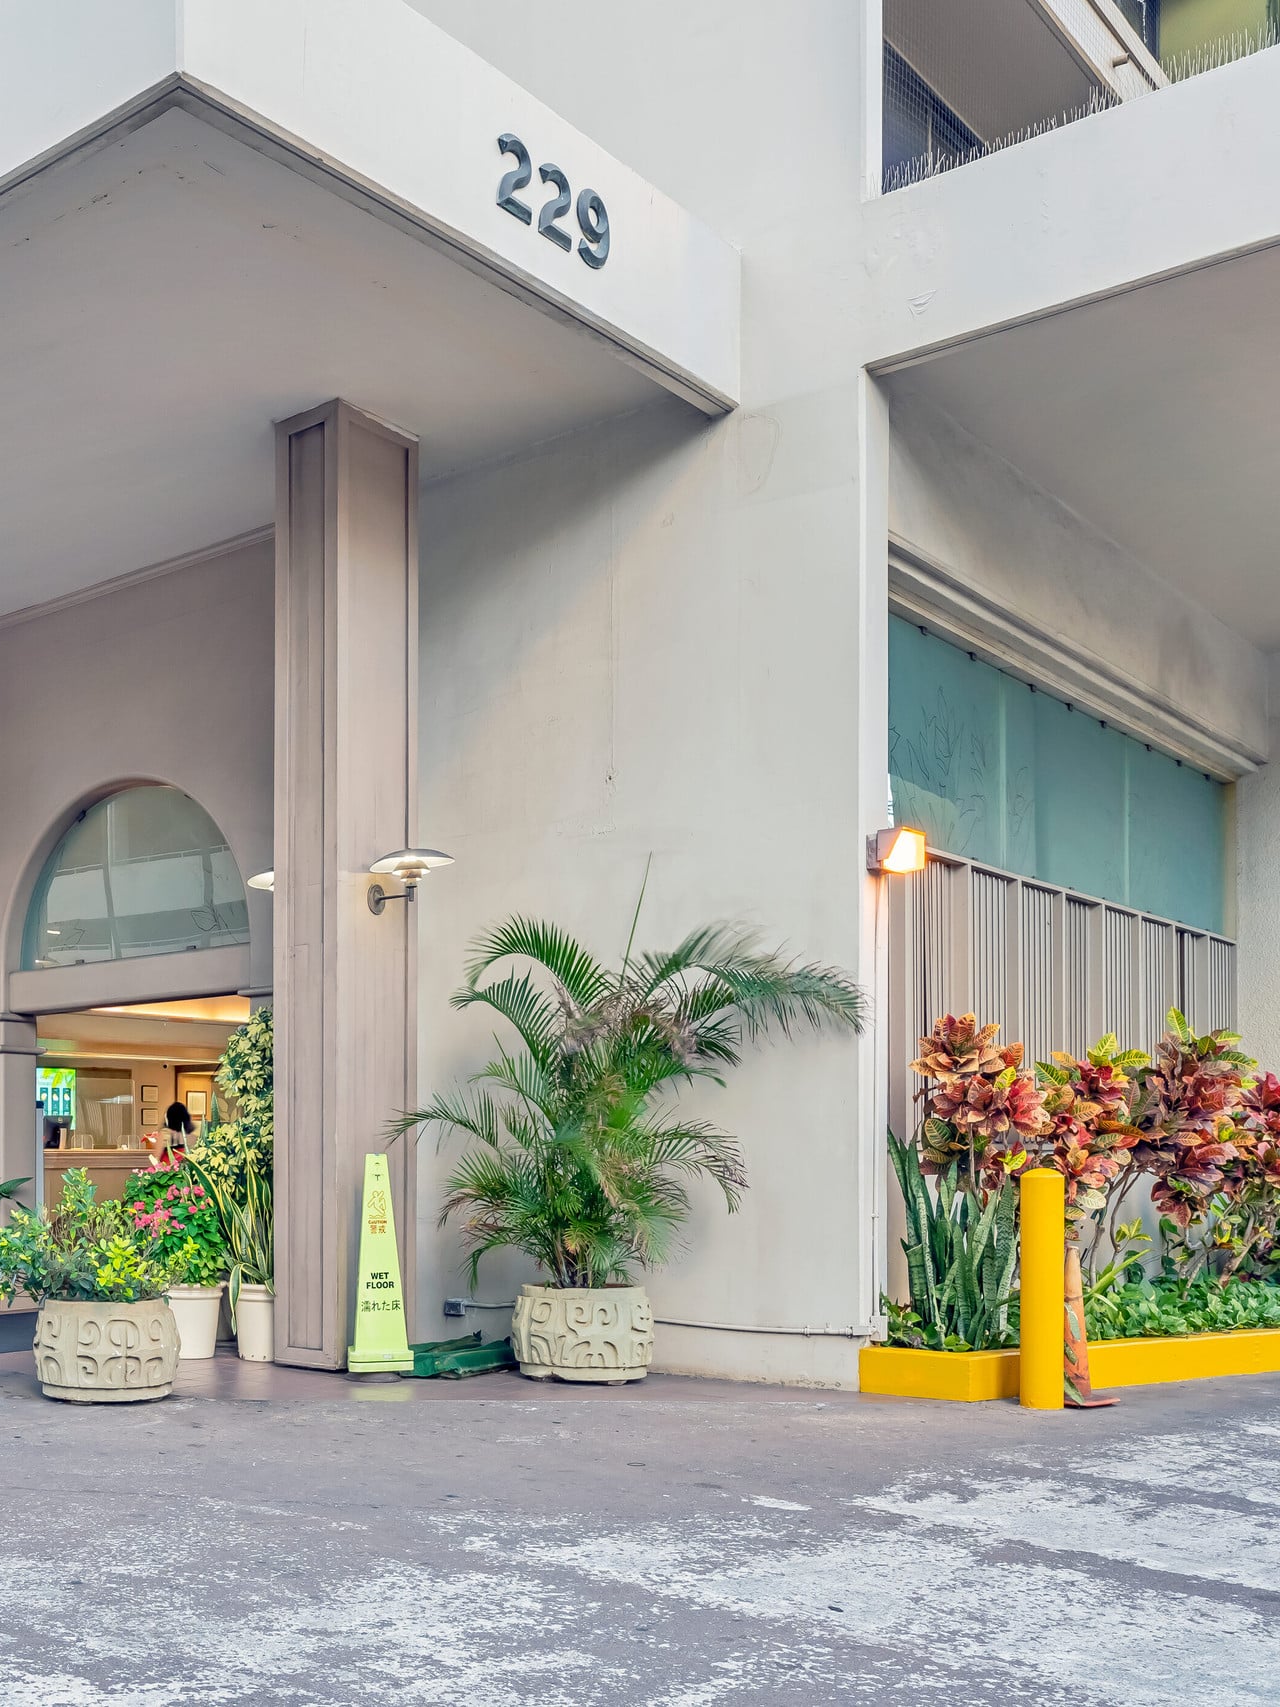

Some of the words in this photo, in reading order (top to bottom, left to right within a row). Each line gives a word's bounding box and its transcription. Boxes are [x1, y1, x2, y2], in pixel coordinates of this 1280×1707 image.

[496, 132, 610, 269] 229
[370, 1272, 390, 1280] WET
[366, 1281, 395, 1289] FLOOR
[361, 1300, 401, 1312] 濡れた床
